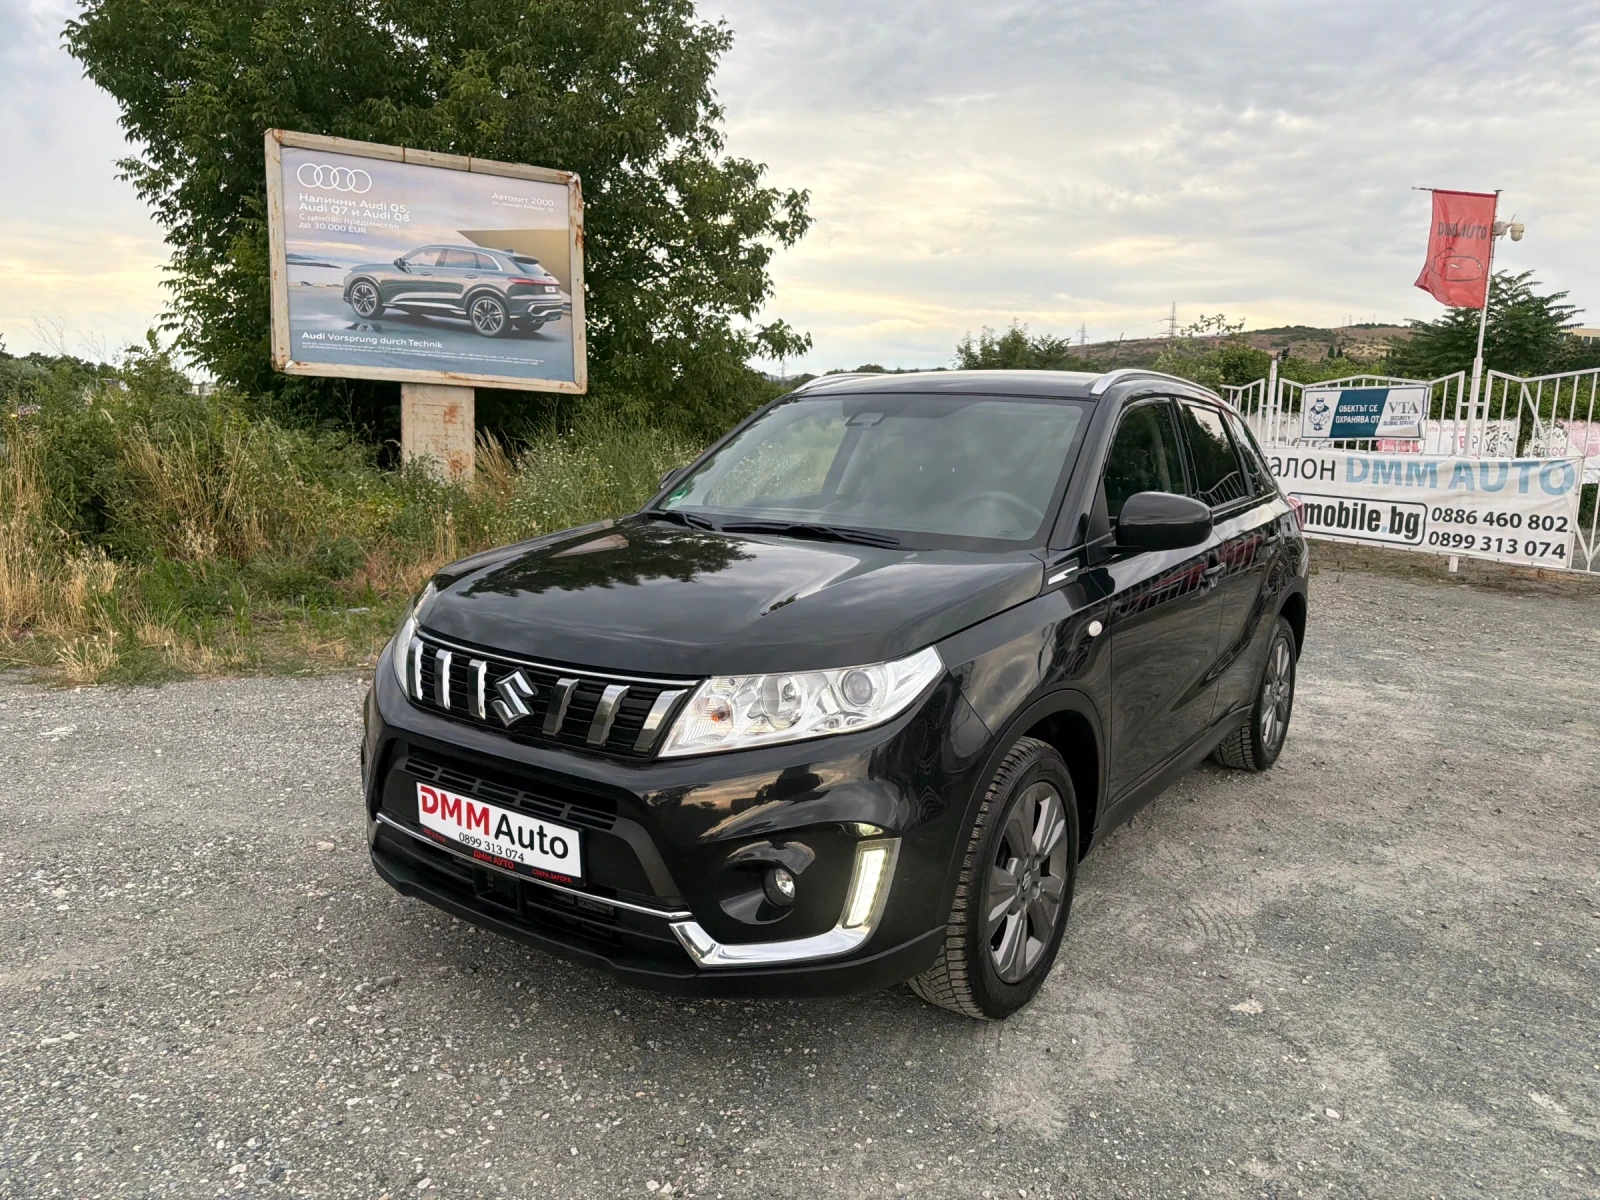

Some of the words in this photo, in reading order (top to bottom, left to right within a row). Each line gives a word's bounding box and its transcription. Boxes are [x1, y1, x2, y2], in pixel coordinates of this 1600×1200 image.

[299, 193, 356, 207] Налични
[360, 200, 387, 210] Audi
[492, 192, 528, 203] Автохит
[531, 197, 553, 206] 2000
[299, 202, 328, 212] Audi
[331, 205, 347, 215] Q7
[352, 208, 360, 216] и
[363, 210, 390, 220] Audi
[394, 212, 410, 222] Q8
[307, 214, 342, 223] ценово
[344, 218, 399, 230] предимство
[314, 222, 326, 230] 30
[328, 224, 346, 232] 000
[348, 225, 367, 234] EUR
[1460, 224, 1487, 239] AUTO
[302, 331, 325, 340] Audi
[327, 333, 377, 345] Vorsprung
[380, 337, 407, 346] durch
[409, 339, 443, 348] Technik
[1369, 404, 1378, 412] СЕ
[1388, 402, 1418, 413] VTA
[1370, 415, 1380, 423] ОТ
[1268, 456, 1336, 481] алон
[1346, 455, 1438, 489] DMM
[1448, 458, 1576, 496] AUTO
[1304, 499, 1420, 540] mobile.bg
[1432, 507, 1477, 525] 0886
[1483, 510, 1522, 528] 460
[1528, 514, 1569, 533] 802
[1428, 531, 1476, 550] 0899
[1479, 535, 1521, 554] 313
[1524, 540, 1566, 560] 074
[458, 832, 482, 848] 0899
[484, 839, 503, 855] 313
[505, 847, 525, 862] 074
[473, 849, 492, 864] ДММ
[493, 855, 515, 870] АУТО
[550, 873, 572, 883] ЗАГОРА
